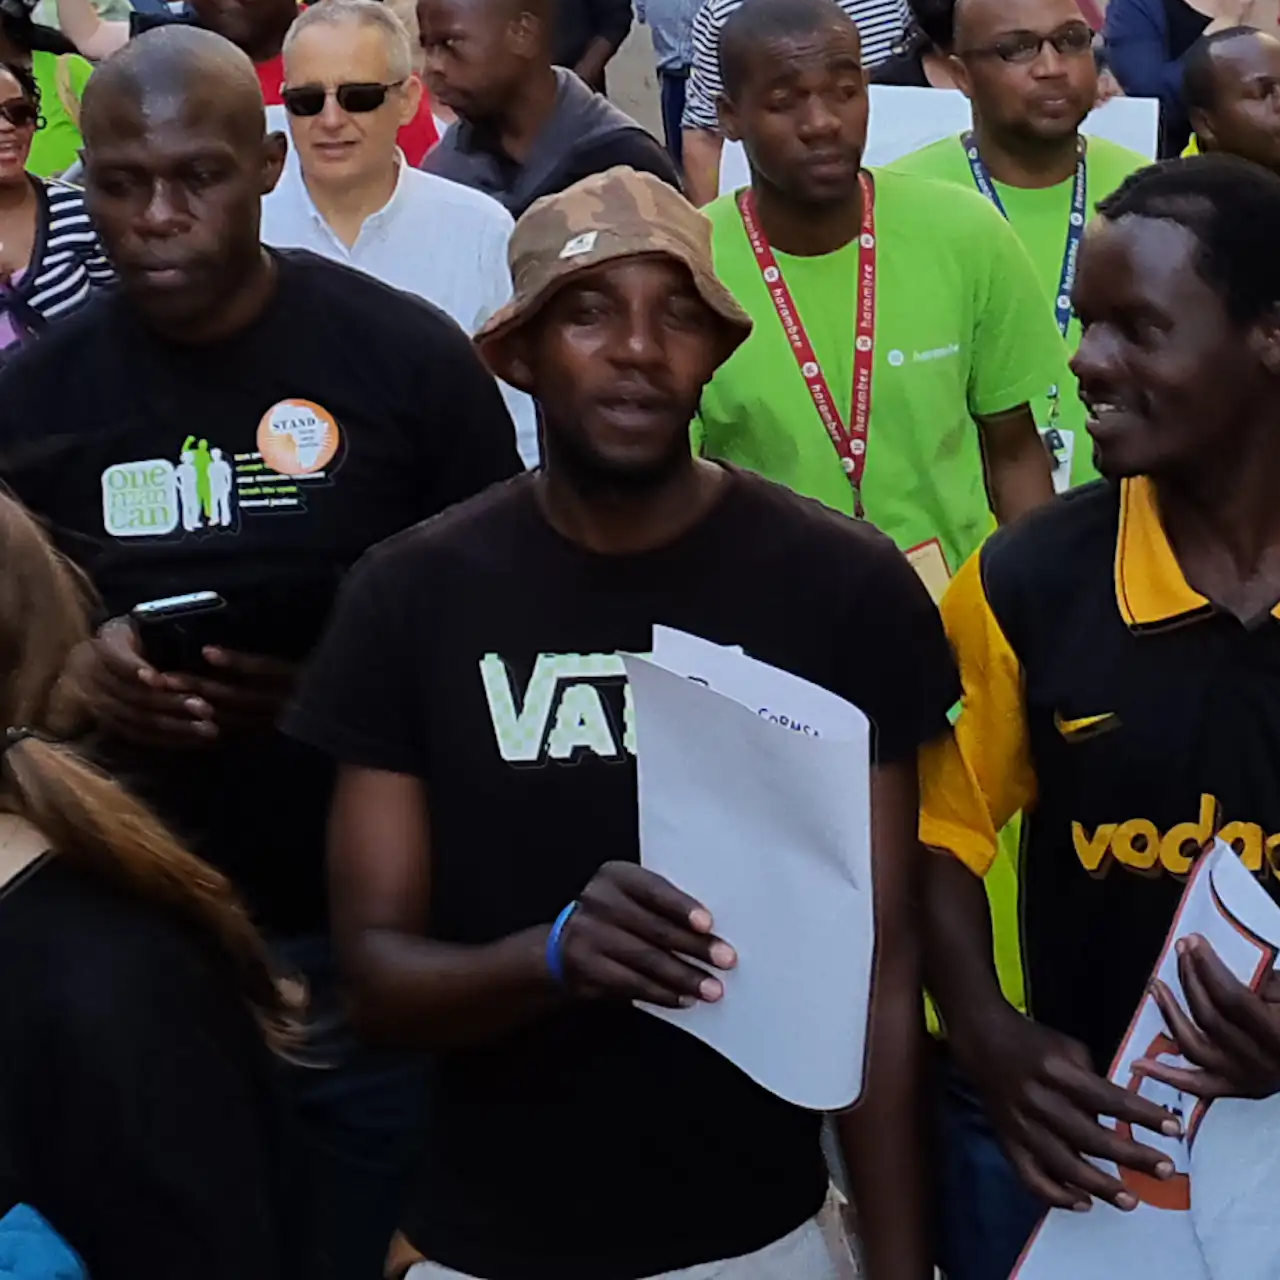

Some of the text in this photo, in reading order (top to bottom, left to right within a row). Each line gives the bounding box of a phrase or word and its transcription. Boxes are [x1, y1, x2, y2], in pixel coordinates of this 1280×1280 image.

[771, 287, 803, 349] harambee
[860, 263, 874, 328] harambee
[273, 417, 317, 431] STAND
[810, 383, 841, 442] harambee
[852, 368, 869, 432] harambee
[479, 652, 640, 762] VA
